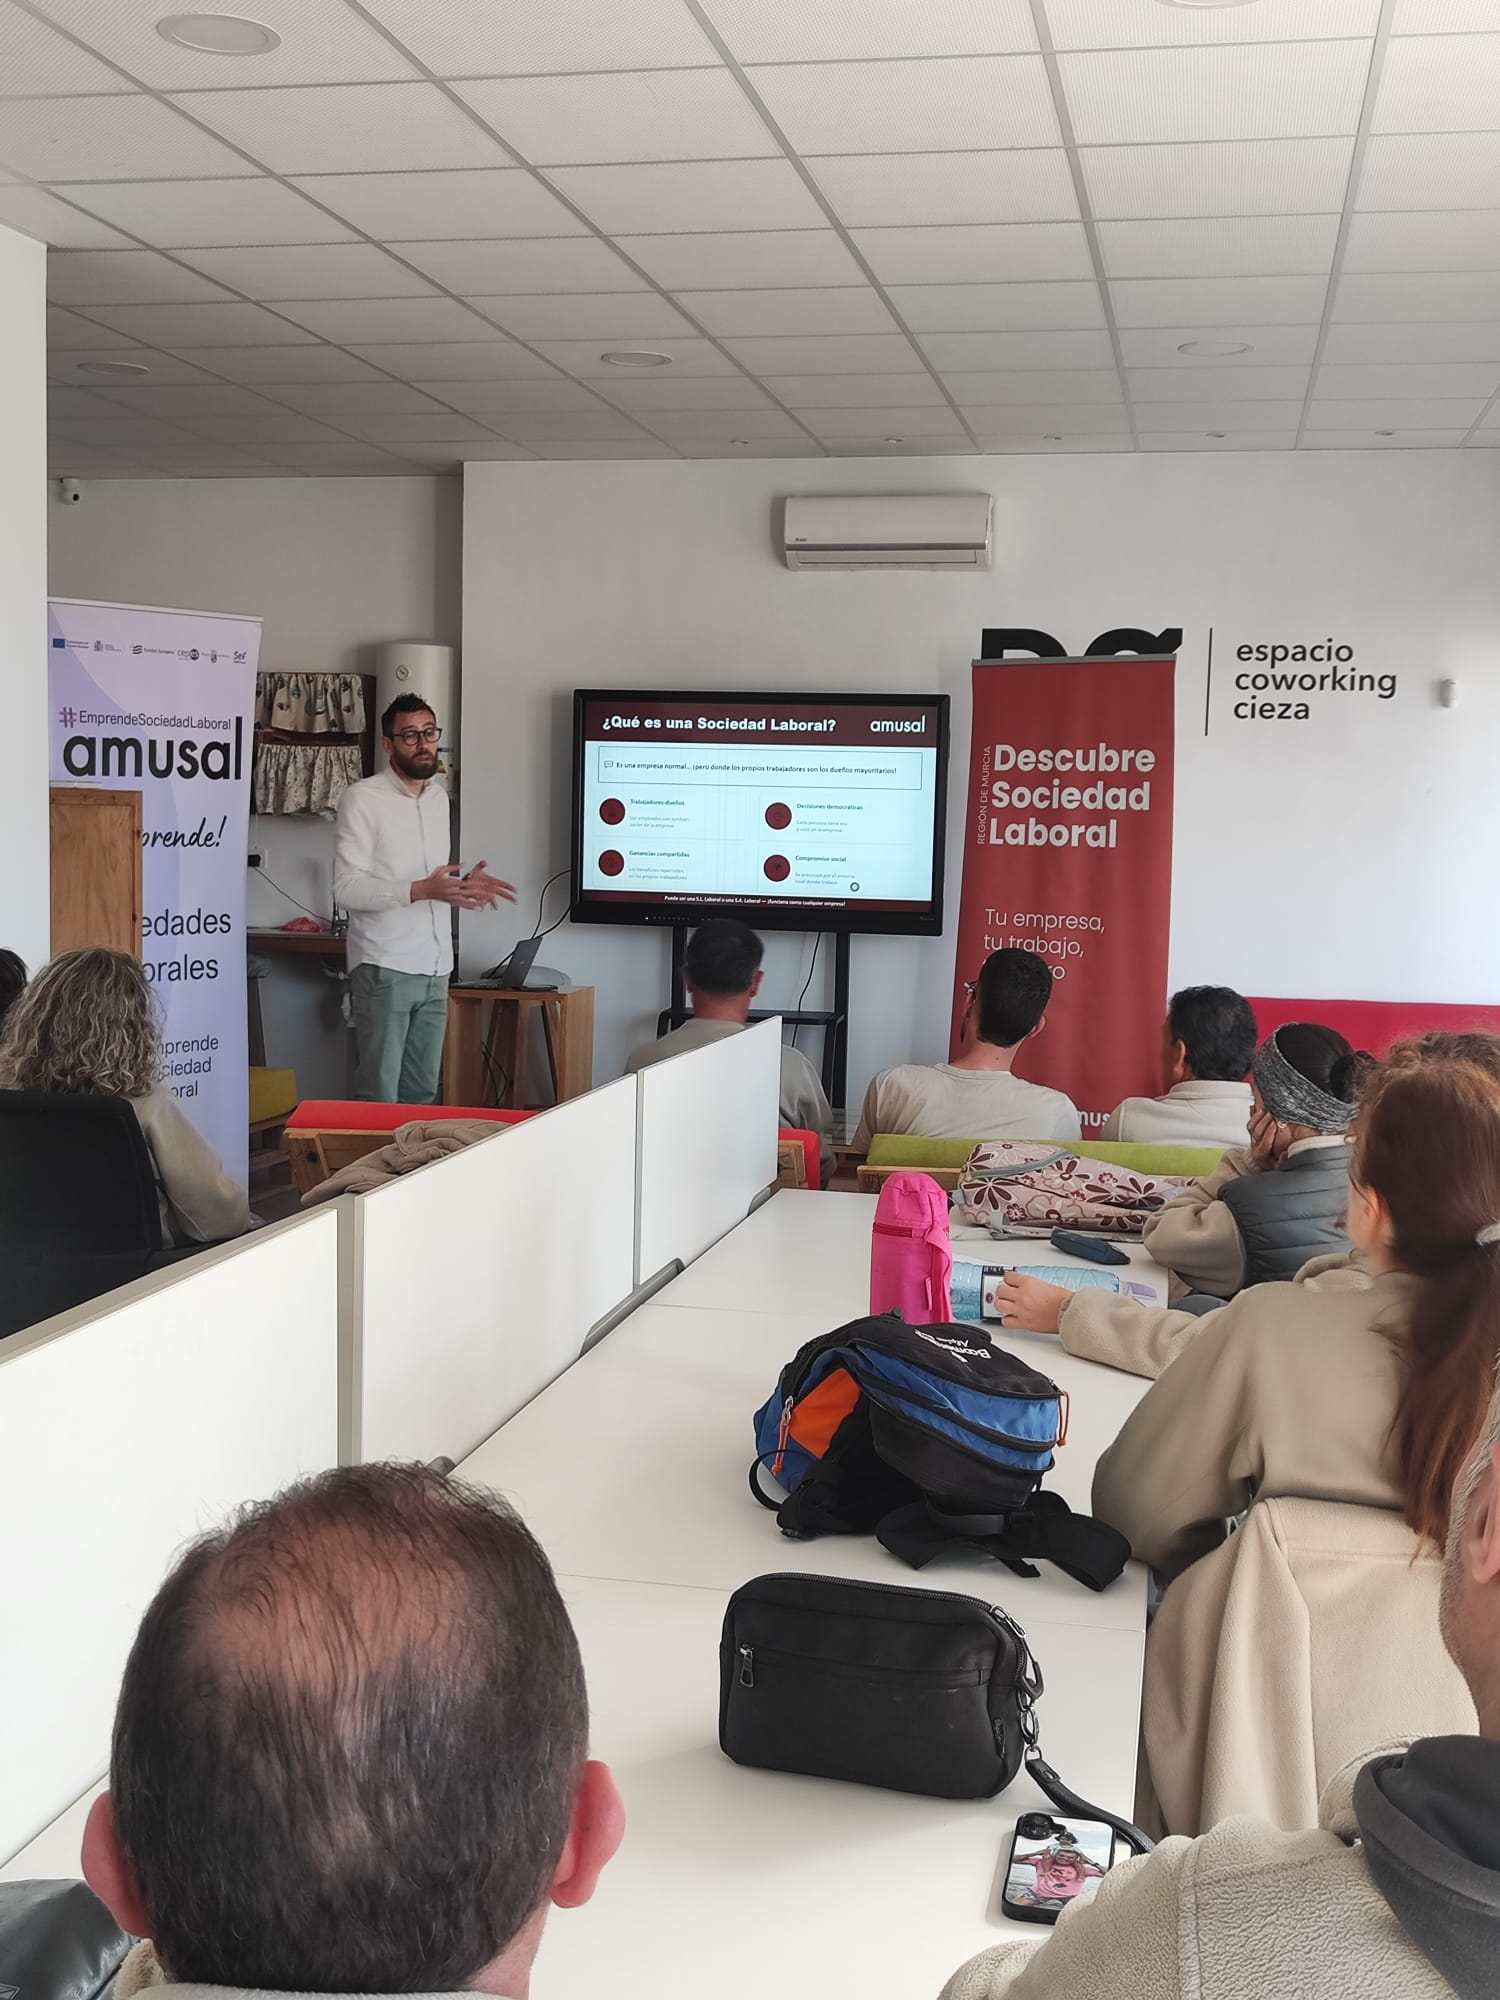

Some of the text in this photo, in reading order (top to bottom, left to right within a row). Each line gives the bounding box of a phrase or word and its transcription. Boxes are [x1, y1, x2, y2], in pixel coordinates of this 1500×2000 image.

[1237, 638, 1353, 669] espacio
[1235, 665, 1397, 699] coworking
[59, 706, 231, 730] #EmprendeSociedadLaboral
[1234, 695, 1310, 720] cieza
[602, 715, 837, 732] ¿Qué es una Sociedad Laboral?
[870, 714, 926, 733] amusal
[63, 716, 243, 780] amusal
[994, 742, 1156, 772] Descubre
[710, 763, 730, 771] donde
[741, 765, 765, 773] propios
[766, 765, 805, 773] trabajadores
[977, 745, 991, 845] REGIÓN DE MURCIA
[992, 778, 1150, 811] Sociedad
[989, 817, 1118, 848] Laboral
[142, 907, 231, 937] edades
[985, 908, 1105, 934] Tu empresa,
[984, 934, 1084, 960] tu trabajo,
[143, 953, 218, 983] orales
[157, 1034, 219, 1058] prende
[162, 1056, 211, 1077] ciedad
